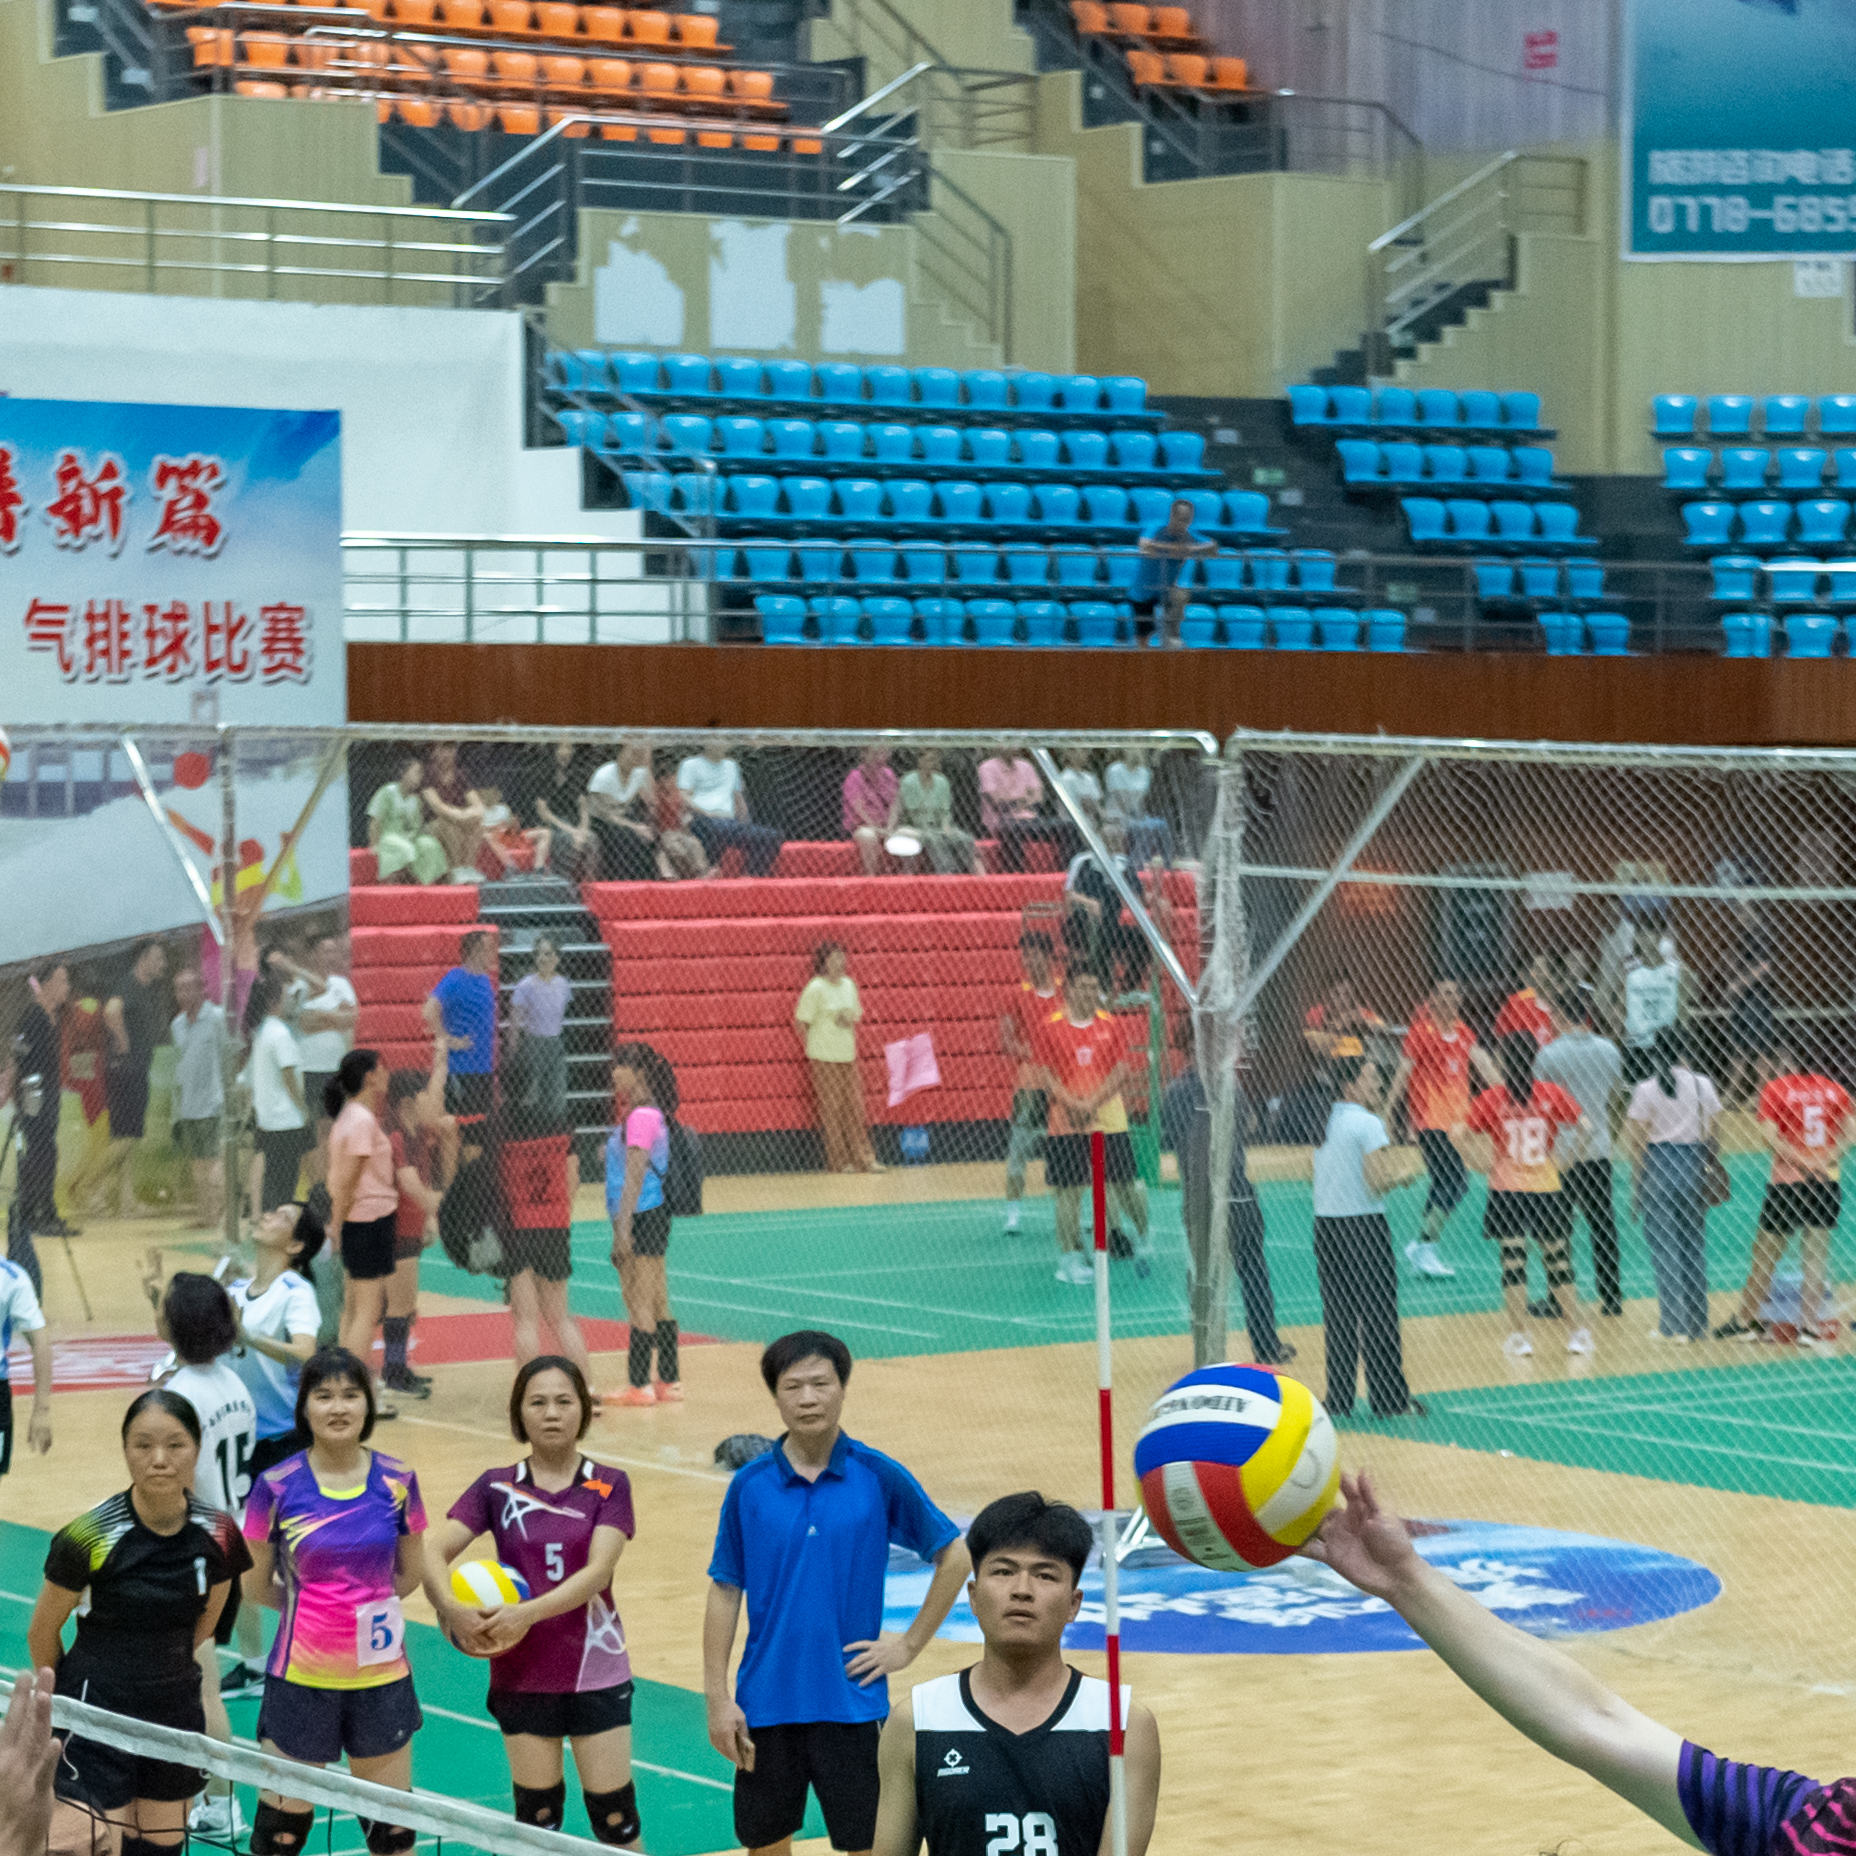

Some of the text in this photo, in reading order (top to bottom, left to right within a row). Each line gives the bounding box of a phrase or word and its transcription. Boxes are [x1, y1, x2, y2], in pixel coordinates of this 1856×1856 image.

[1502, 1116, 1547, 1167] 18
[1803, 1105, 1827, 1148] 5
[545, 1542, 564, 1582] 5
[370, 1611, 394, 1651] 5
